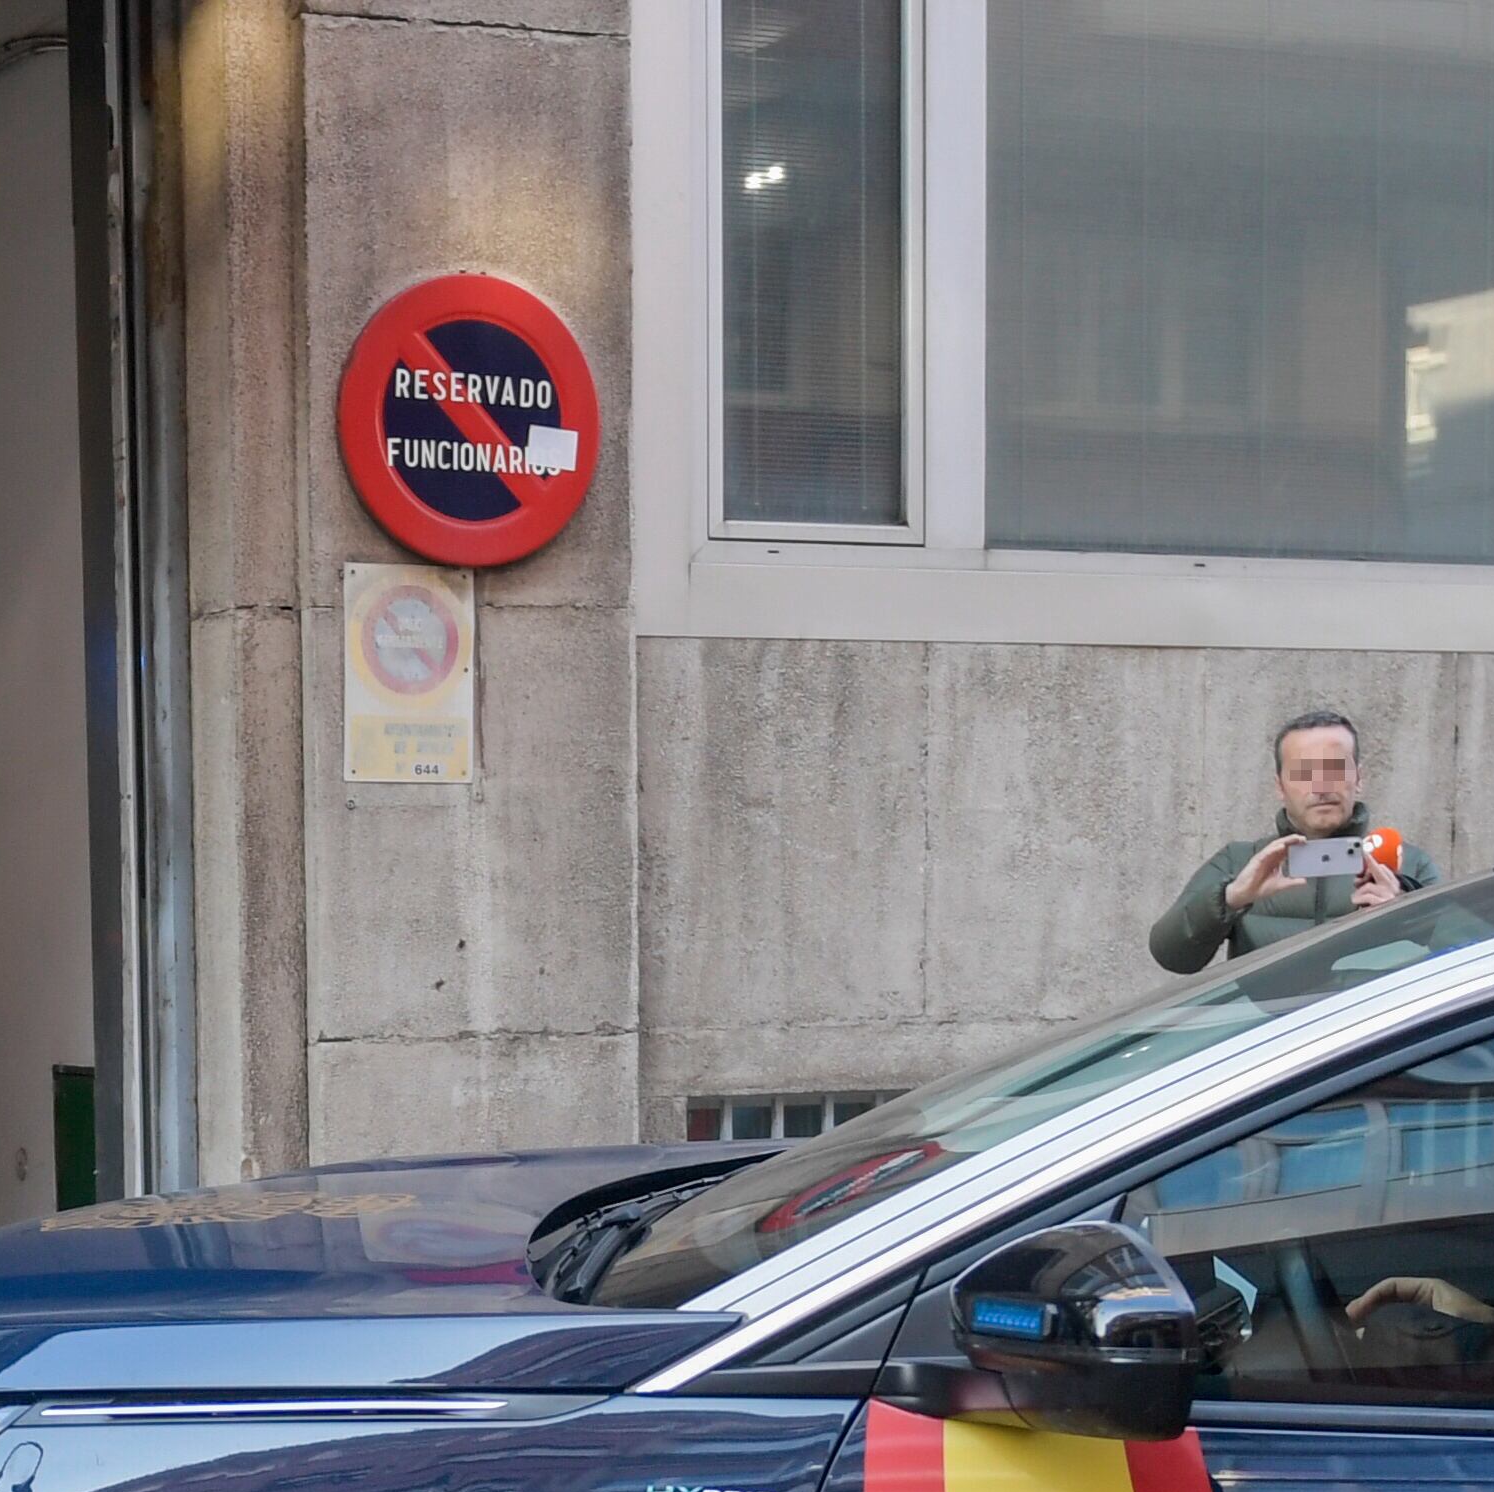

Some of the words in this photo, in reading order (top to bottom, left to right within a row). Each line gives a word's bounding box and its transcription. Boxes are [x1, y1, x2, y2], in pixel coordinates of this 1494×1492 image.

[394, 367, 553, 410] RESERVADO
[386, 436, 562, 477] FUNCIONARI
[414, 764, 440, 776] 644
